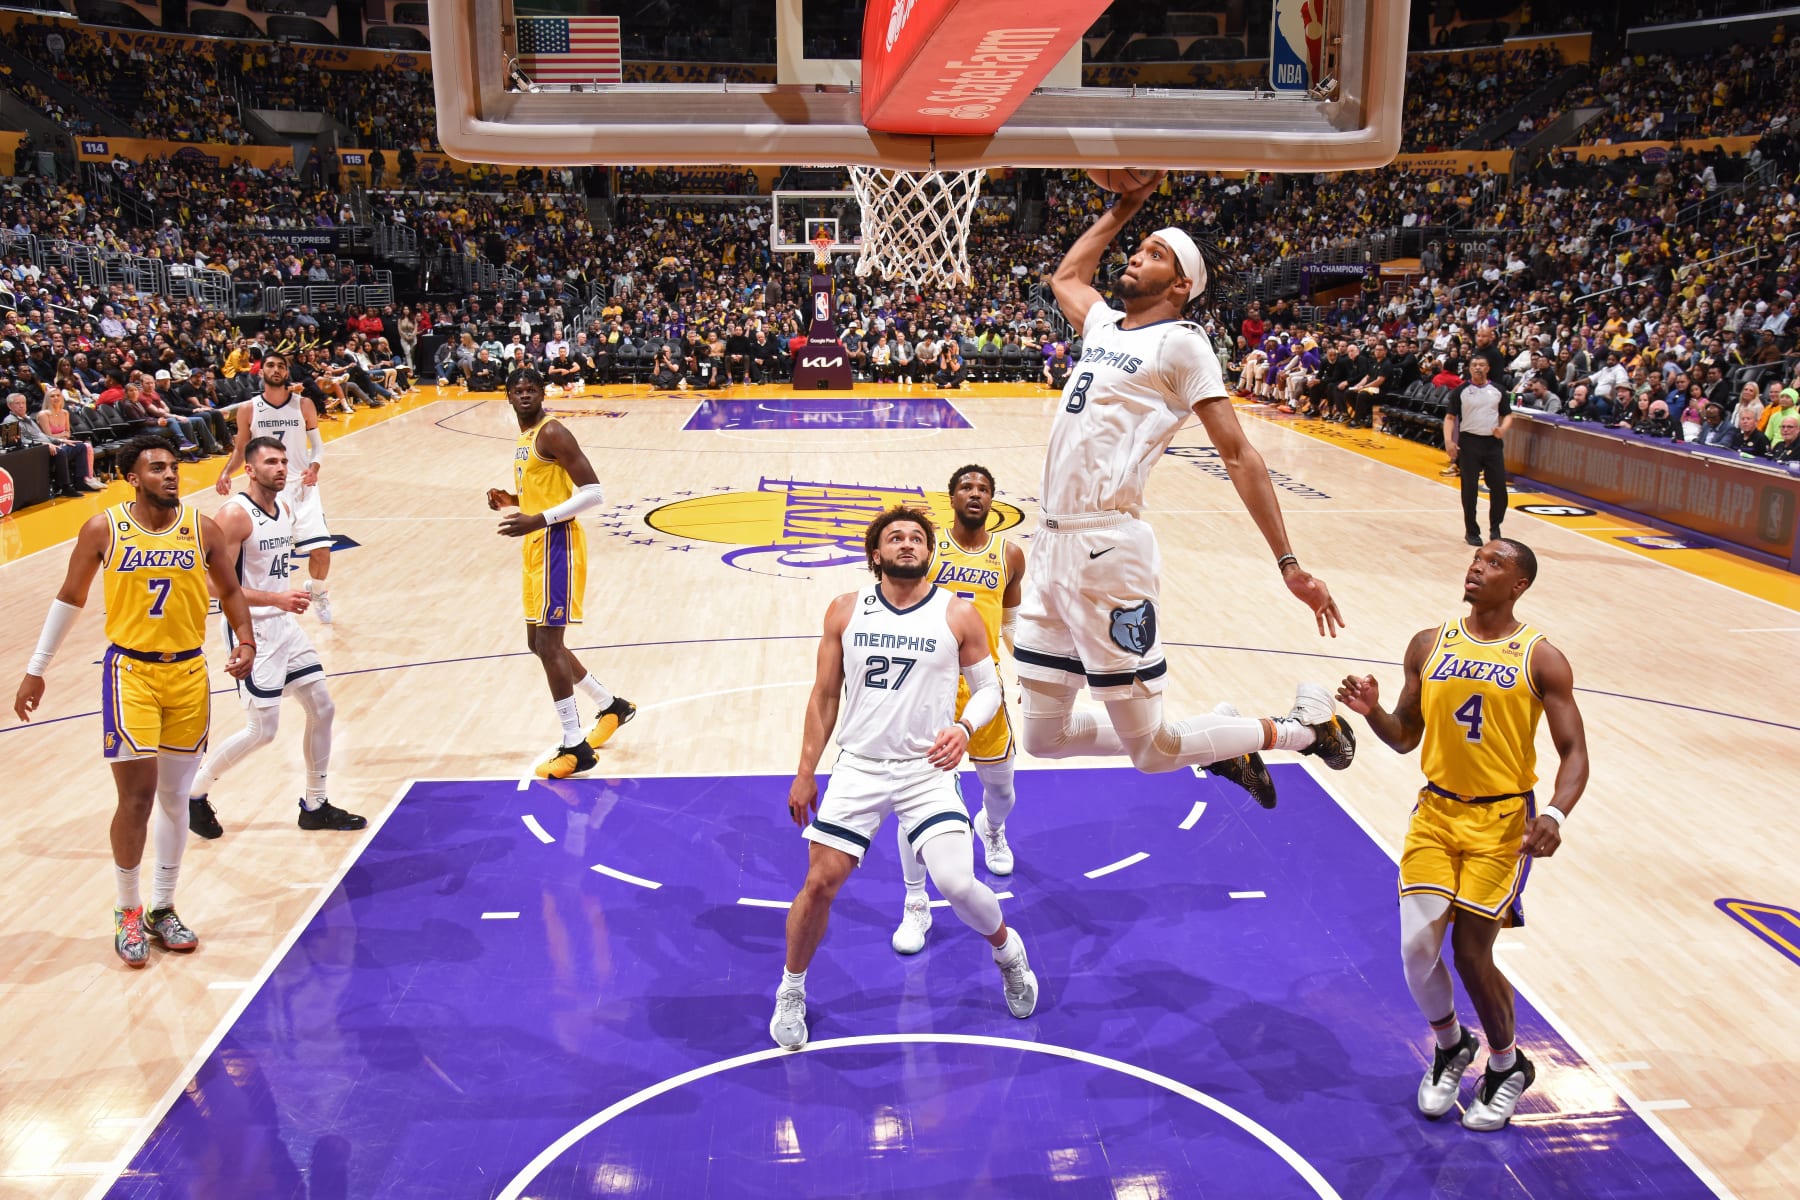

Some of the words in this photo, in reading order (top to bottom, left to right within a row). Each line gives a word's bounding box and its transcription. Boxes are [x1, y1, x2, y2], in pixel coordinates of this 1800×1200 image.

[1278, 64, 1302, 84] NBA
[86, 143, 105, 153] 114
[345, 155, 362, 164] 115
[291, 236, 331, 244] EXPRESS
[1321, 265, 1364, 274] CHAMPIONS
[1066, 371, 1094, 414] 8
[258, 419, 300, 428] MEMPHIS
[1539, 436, 1585, 481] PLAYOFF
[1585, 447, 1622, 491] MODE
[1623, 456, 1657, 502] WITH
[1658, 464, 1687, 511] THE
[1686, 471, 1719, 521] NBA
[1719, 480, 1755, 529] APP
[116, 545, 196, 572] LAKERS
[932, 560, 1000, 589] LAKERS
[148, 578, 172, 618] 7
[853, 632, 937, 653] MEMPHIS
[1502, 649, 1524, 657] bibigo
[864, 655, 918, 691] 27
[1428, 653, 1519, 689] LAKERS
[1453, 693, 1483, 742] 4
